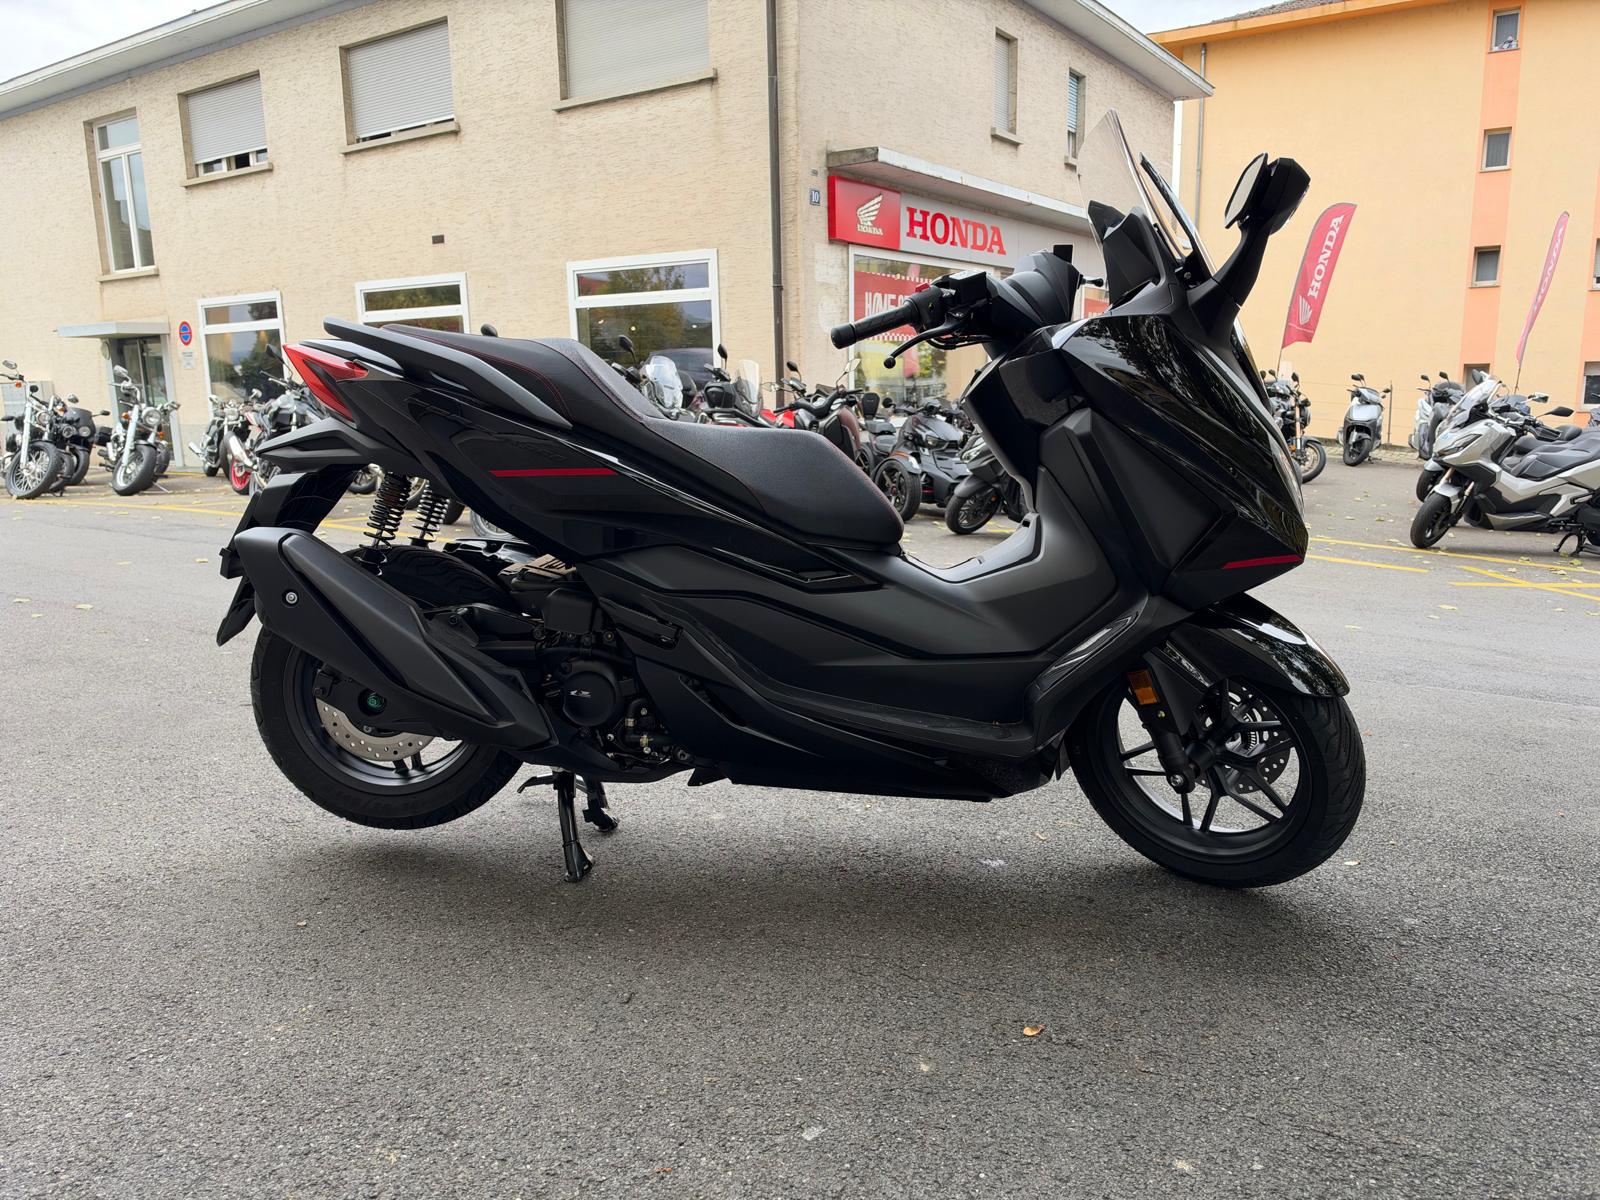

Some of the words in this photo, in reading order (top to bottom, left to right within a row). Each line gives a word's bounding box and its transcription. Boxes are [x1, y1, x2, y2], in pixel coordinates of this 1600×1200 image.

[811, 190, 819, 203] 10
[857, 224, 883, 236] HONDA
[906, 206, 1007, 255] HONDA
[1307, 215, 1345, 299] HONDA
